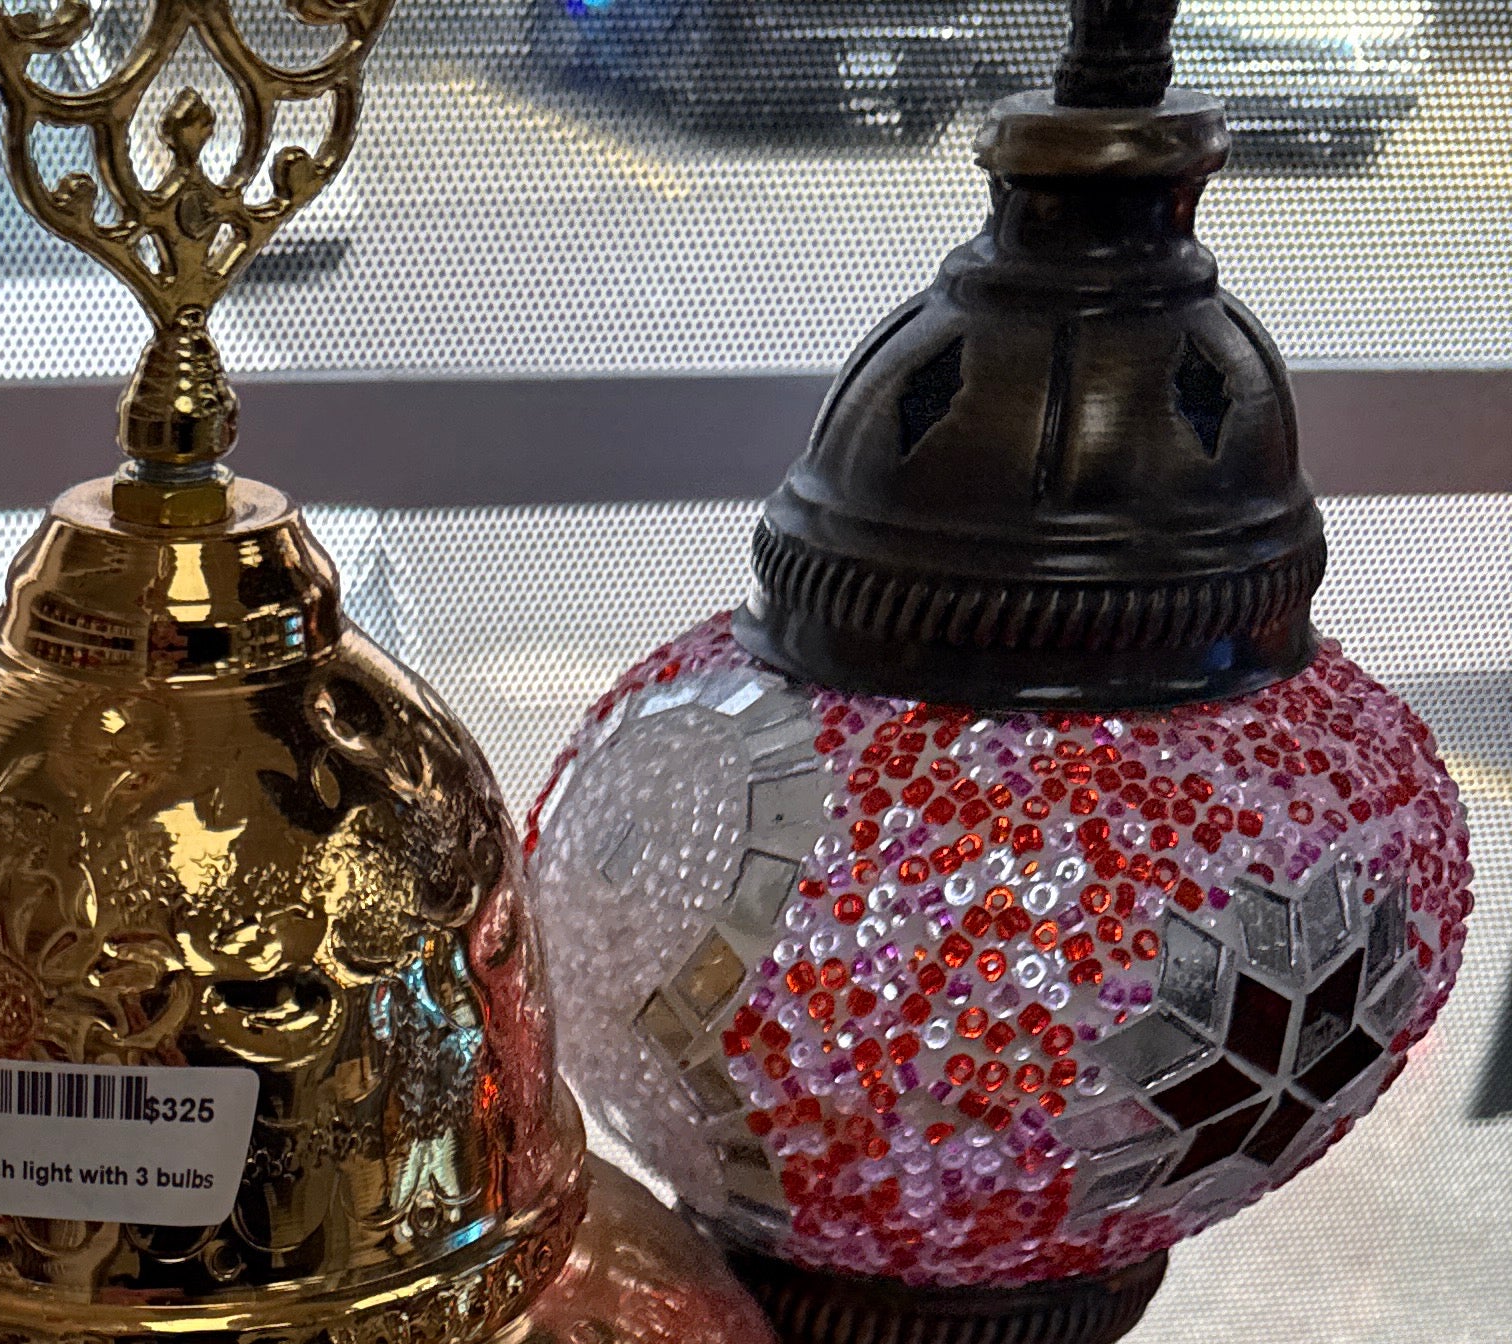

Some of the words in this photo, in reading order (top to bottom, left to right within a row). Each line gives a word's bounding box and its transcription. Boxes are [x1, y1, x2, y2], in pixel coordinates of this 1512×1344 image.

[144, 1095, 215, 1125] $325
[22, 1160, 72, 1187] light
[79, 1163, 129, 1186] with
[136, 1167, 149, 1186] 3
[157, 1168, 214, 1189] bulbs
